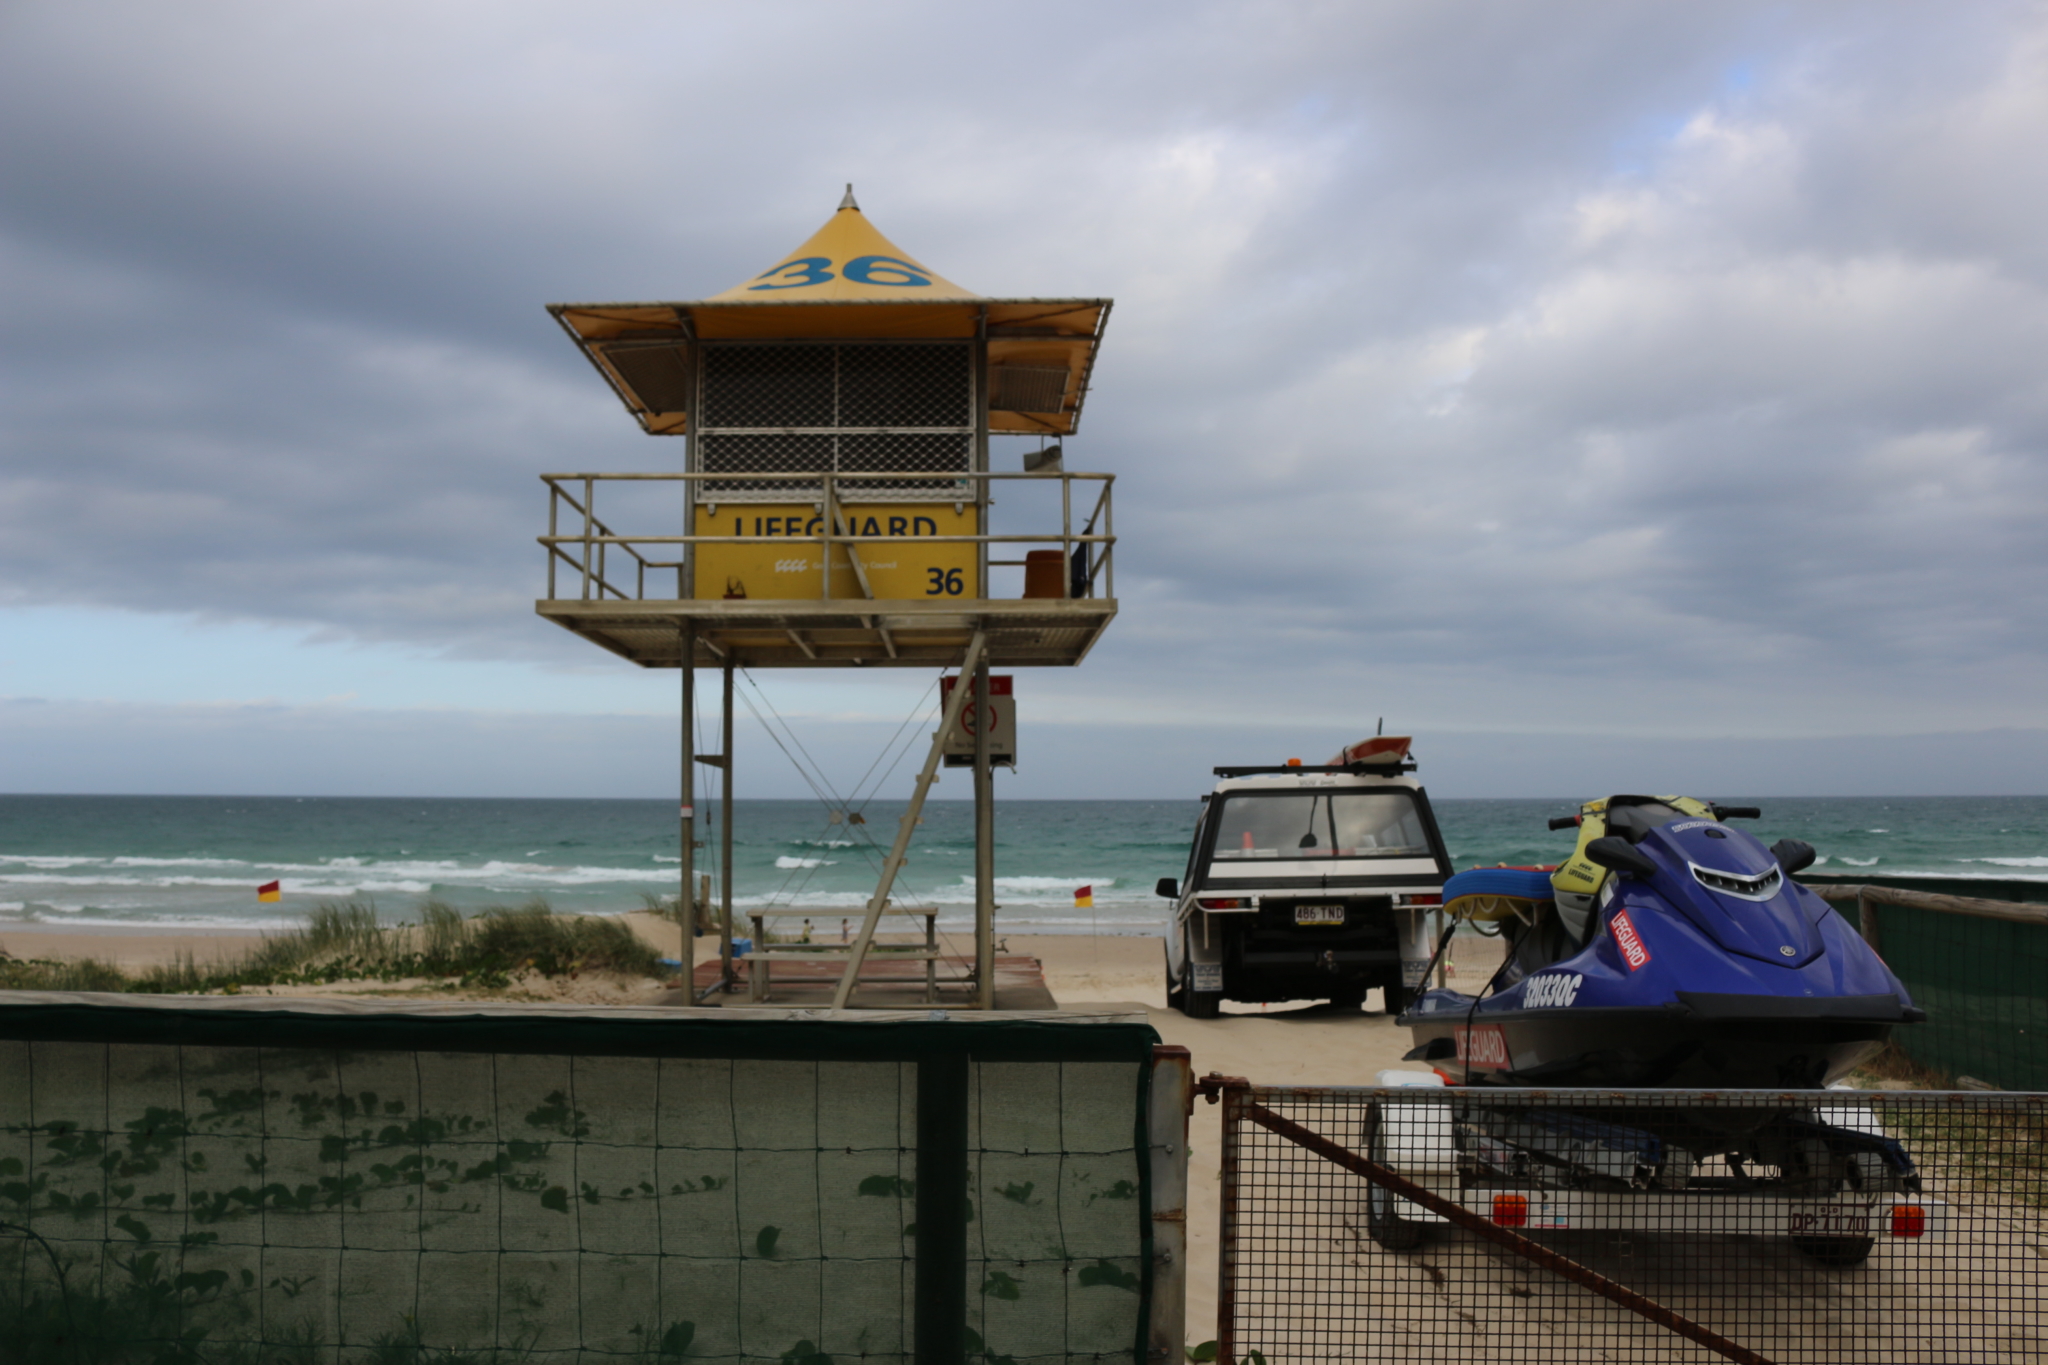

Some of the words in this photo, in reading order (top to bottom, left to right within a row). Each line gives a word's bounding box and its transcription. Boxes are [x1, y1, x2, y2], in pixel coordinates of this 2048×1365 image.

[747, 255, 932, 291] 36
[926, 567, 964, 595] 36
[1611, 911, 1646, 967] LIFEGUARD
[1523, 974, 1583, 1009] 32033QC
